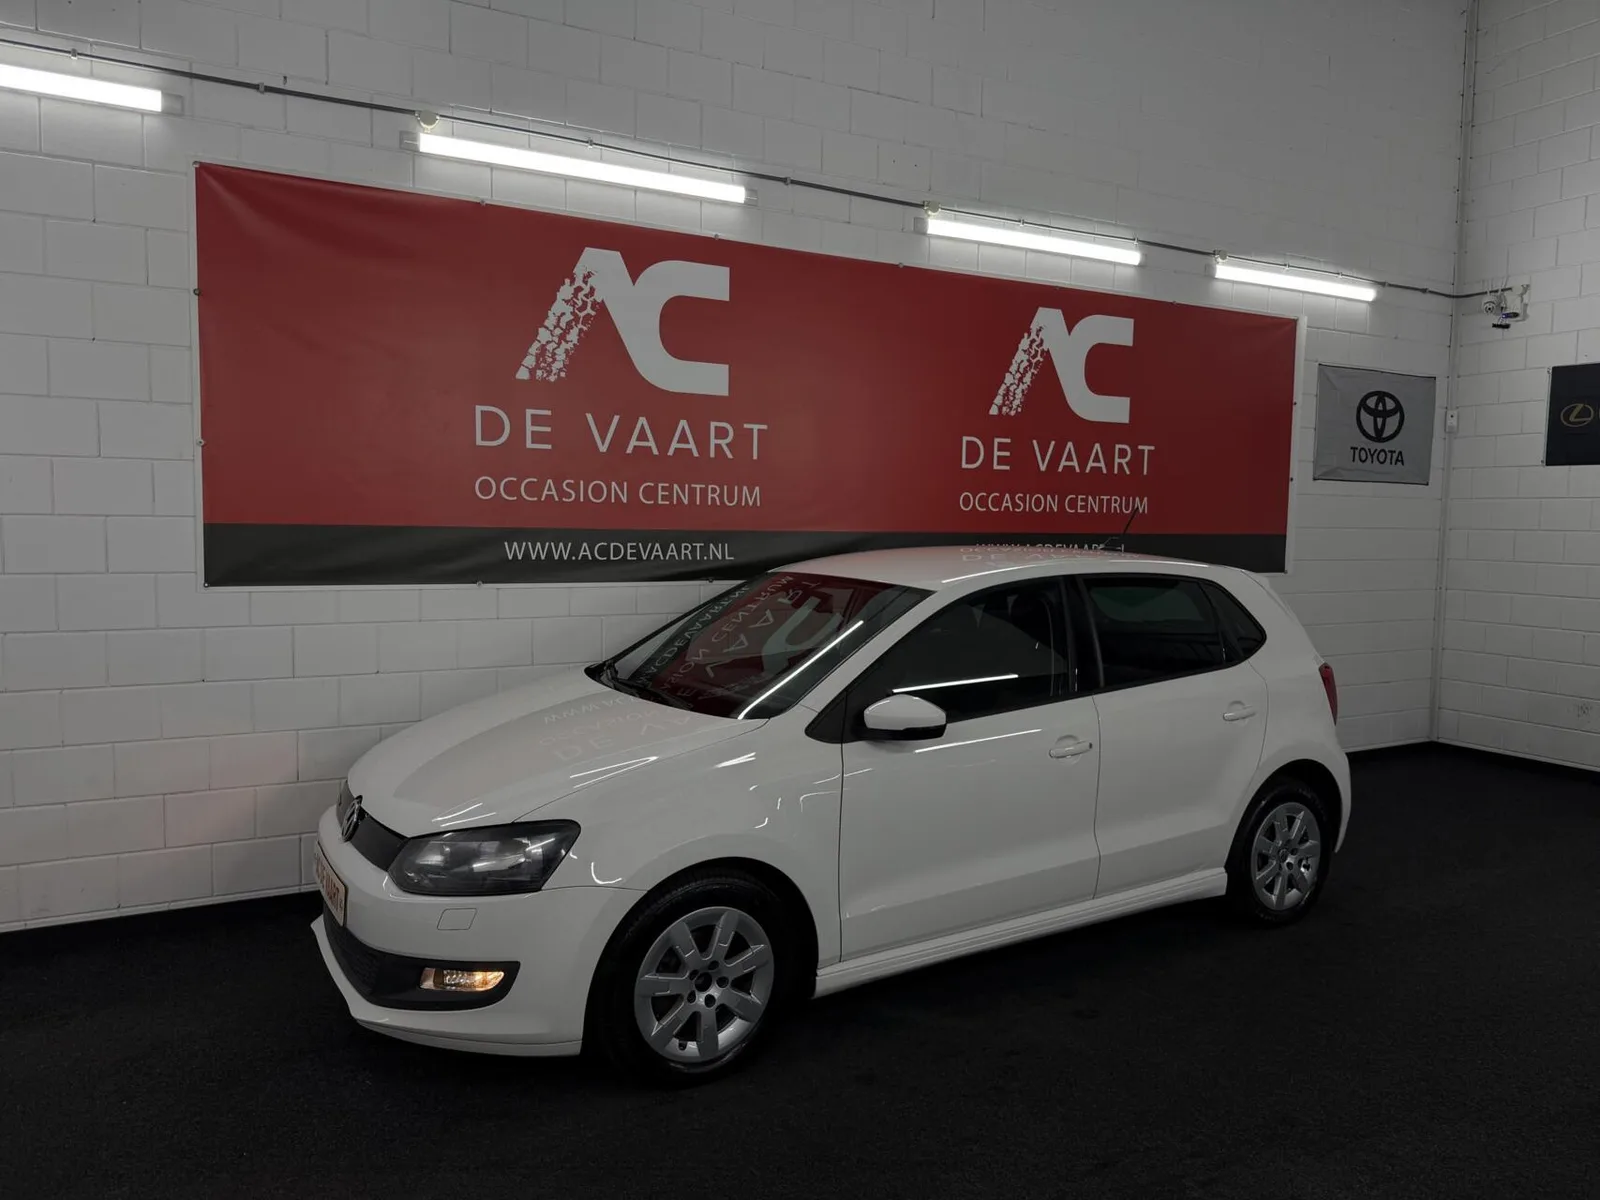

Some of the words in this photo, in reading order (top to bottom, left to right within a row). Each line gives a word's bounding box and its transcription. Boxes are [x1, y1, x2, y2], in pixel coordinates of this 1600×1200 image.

[515, 247, 730, 397] AC
[988, 306, 1135, 424] AC
[475, 405, 552, 450] DE
[585, 412, 768, 460] VAART
[961, 436, 1011, 470] DE
[1032, 439, 1155, 475] VAART
[1350, 446, 1405, 466] TOYOTA
[474, 475, 627, 504] OCCASION
[638, 482, 761, 507] CENTRUM
[959, 491, 1058, 513] OCCASION
[1064, 495, 1148, 514] CENTRUM
[504, 541, 735, 561] WWW.ACDEVAART.NL
